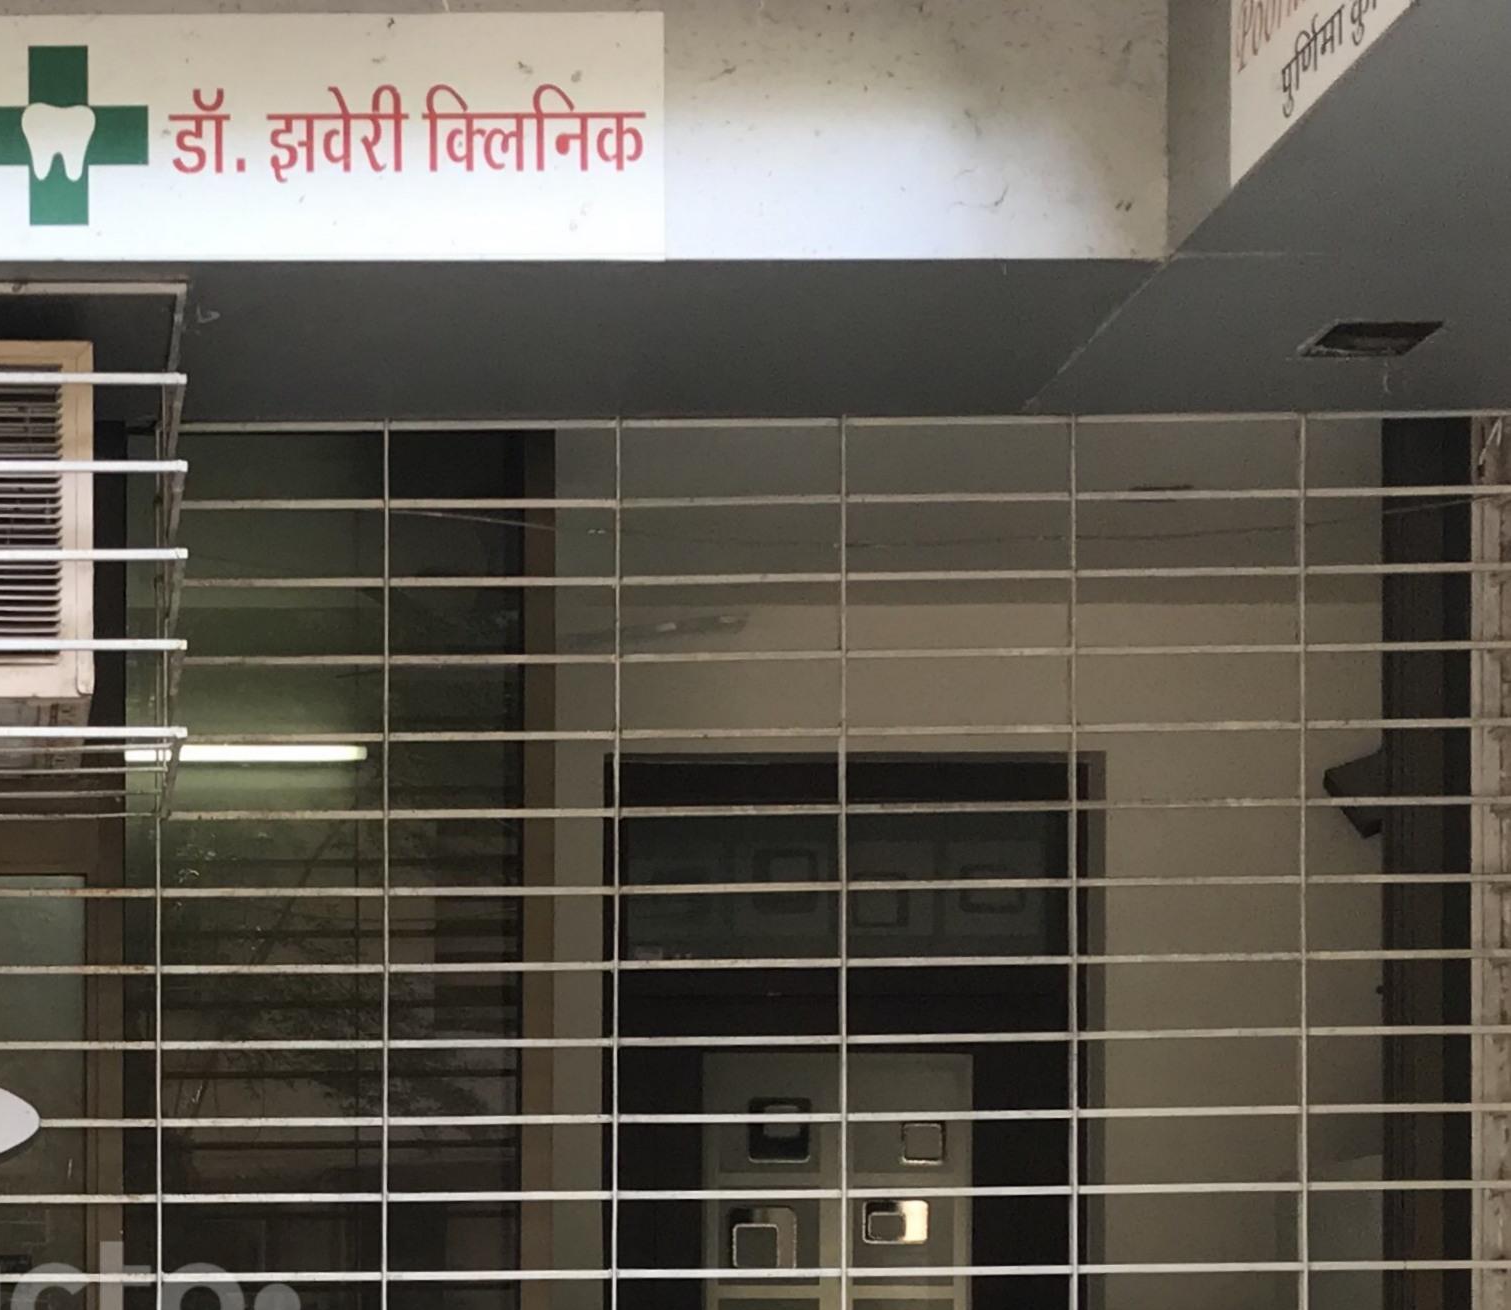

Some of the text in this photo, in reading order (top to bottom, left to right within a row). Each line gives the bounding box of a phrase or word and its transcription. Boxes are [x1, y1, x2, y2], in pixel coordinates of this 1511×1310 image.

[168, 83, 646, 183] डॉ. झवेरी क्लिनिक
